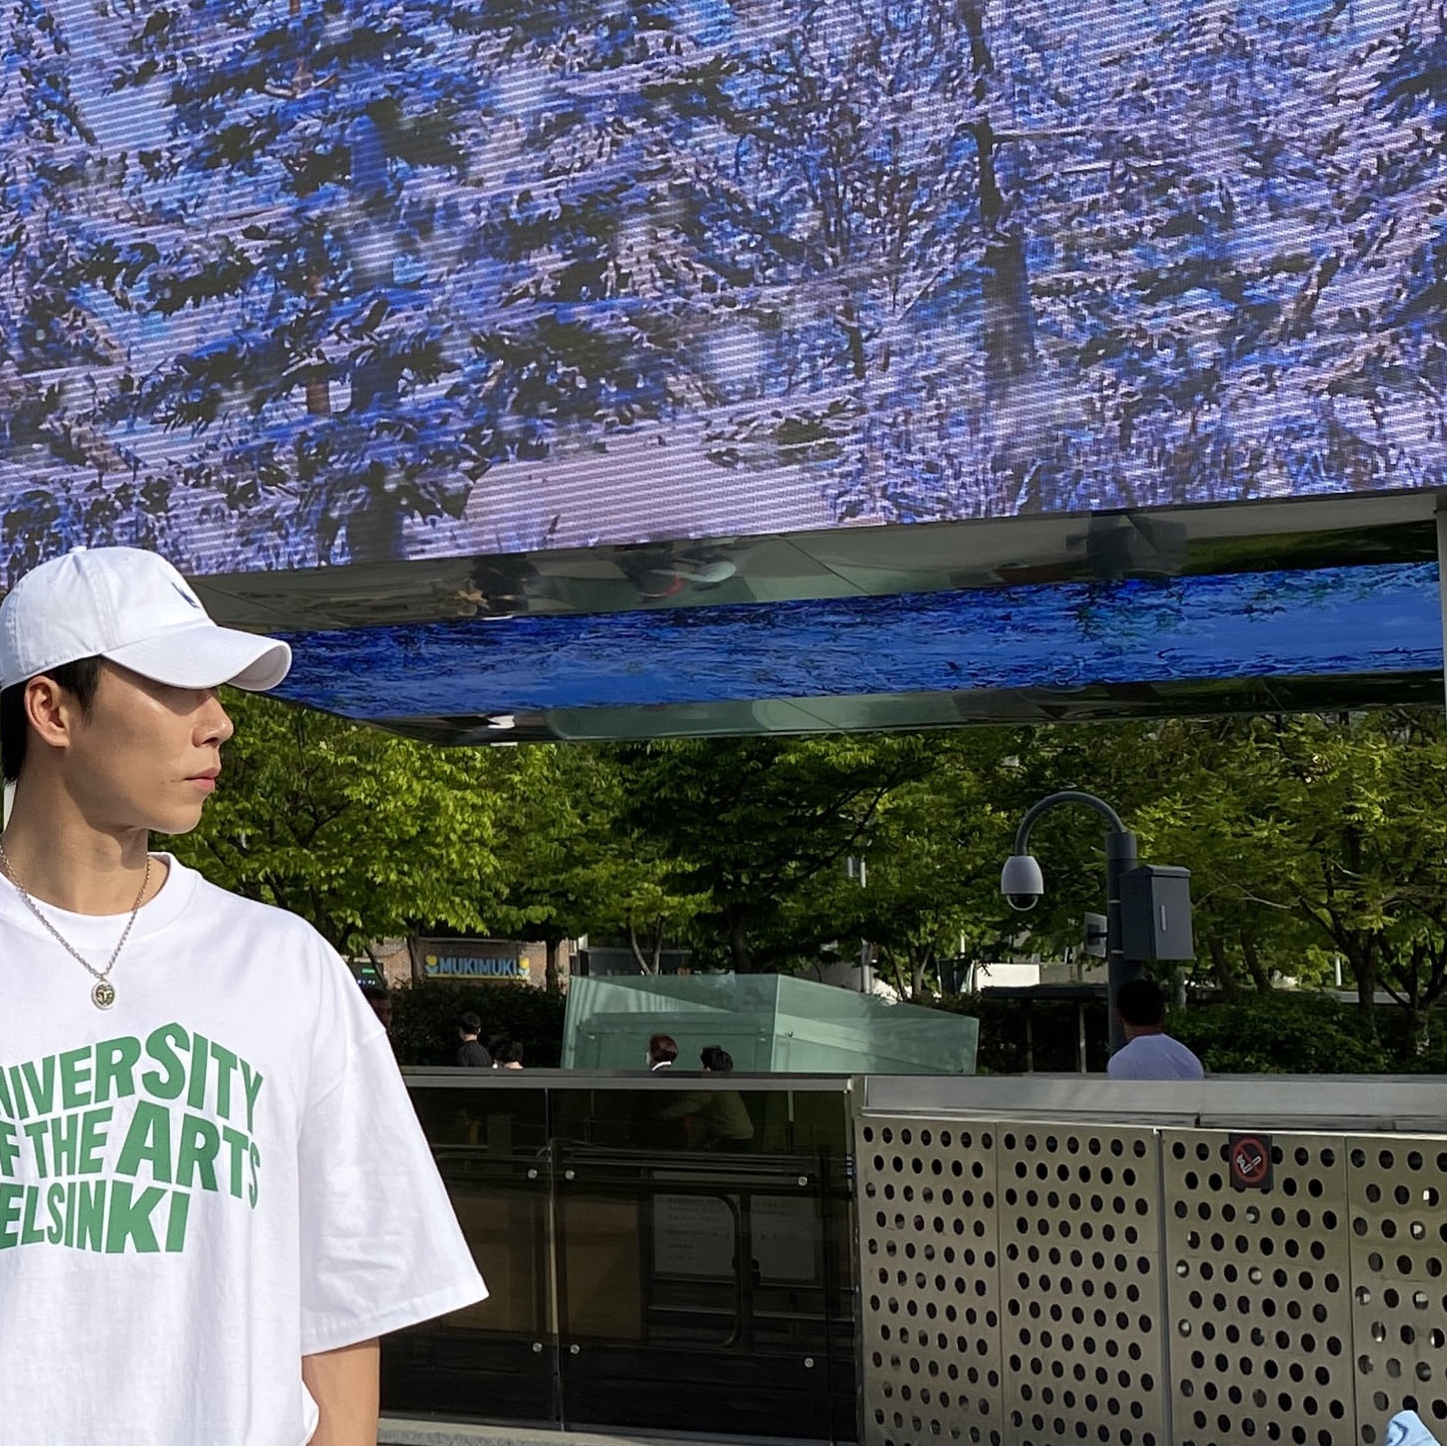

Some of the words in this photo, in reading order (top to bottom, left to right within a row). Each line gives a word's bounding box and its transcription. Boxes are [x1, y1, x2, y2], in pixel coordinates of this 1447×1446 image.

[438, 957, 518, 976] MUKIMUKI
[23, 1106, 114, 1179] THE
[115, 1099, 261, 1210] ARTS
